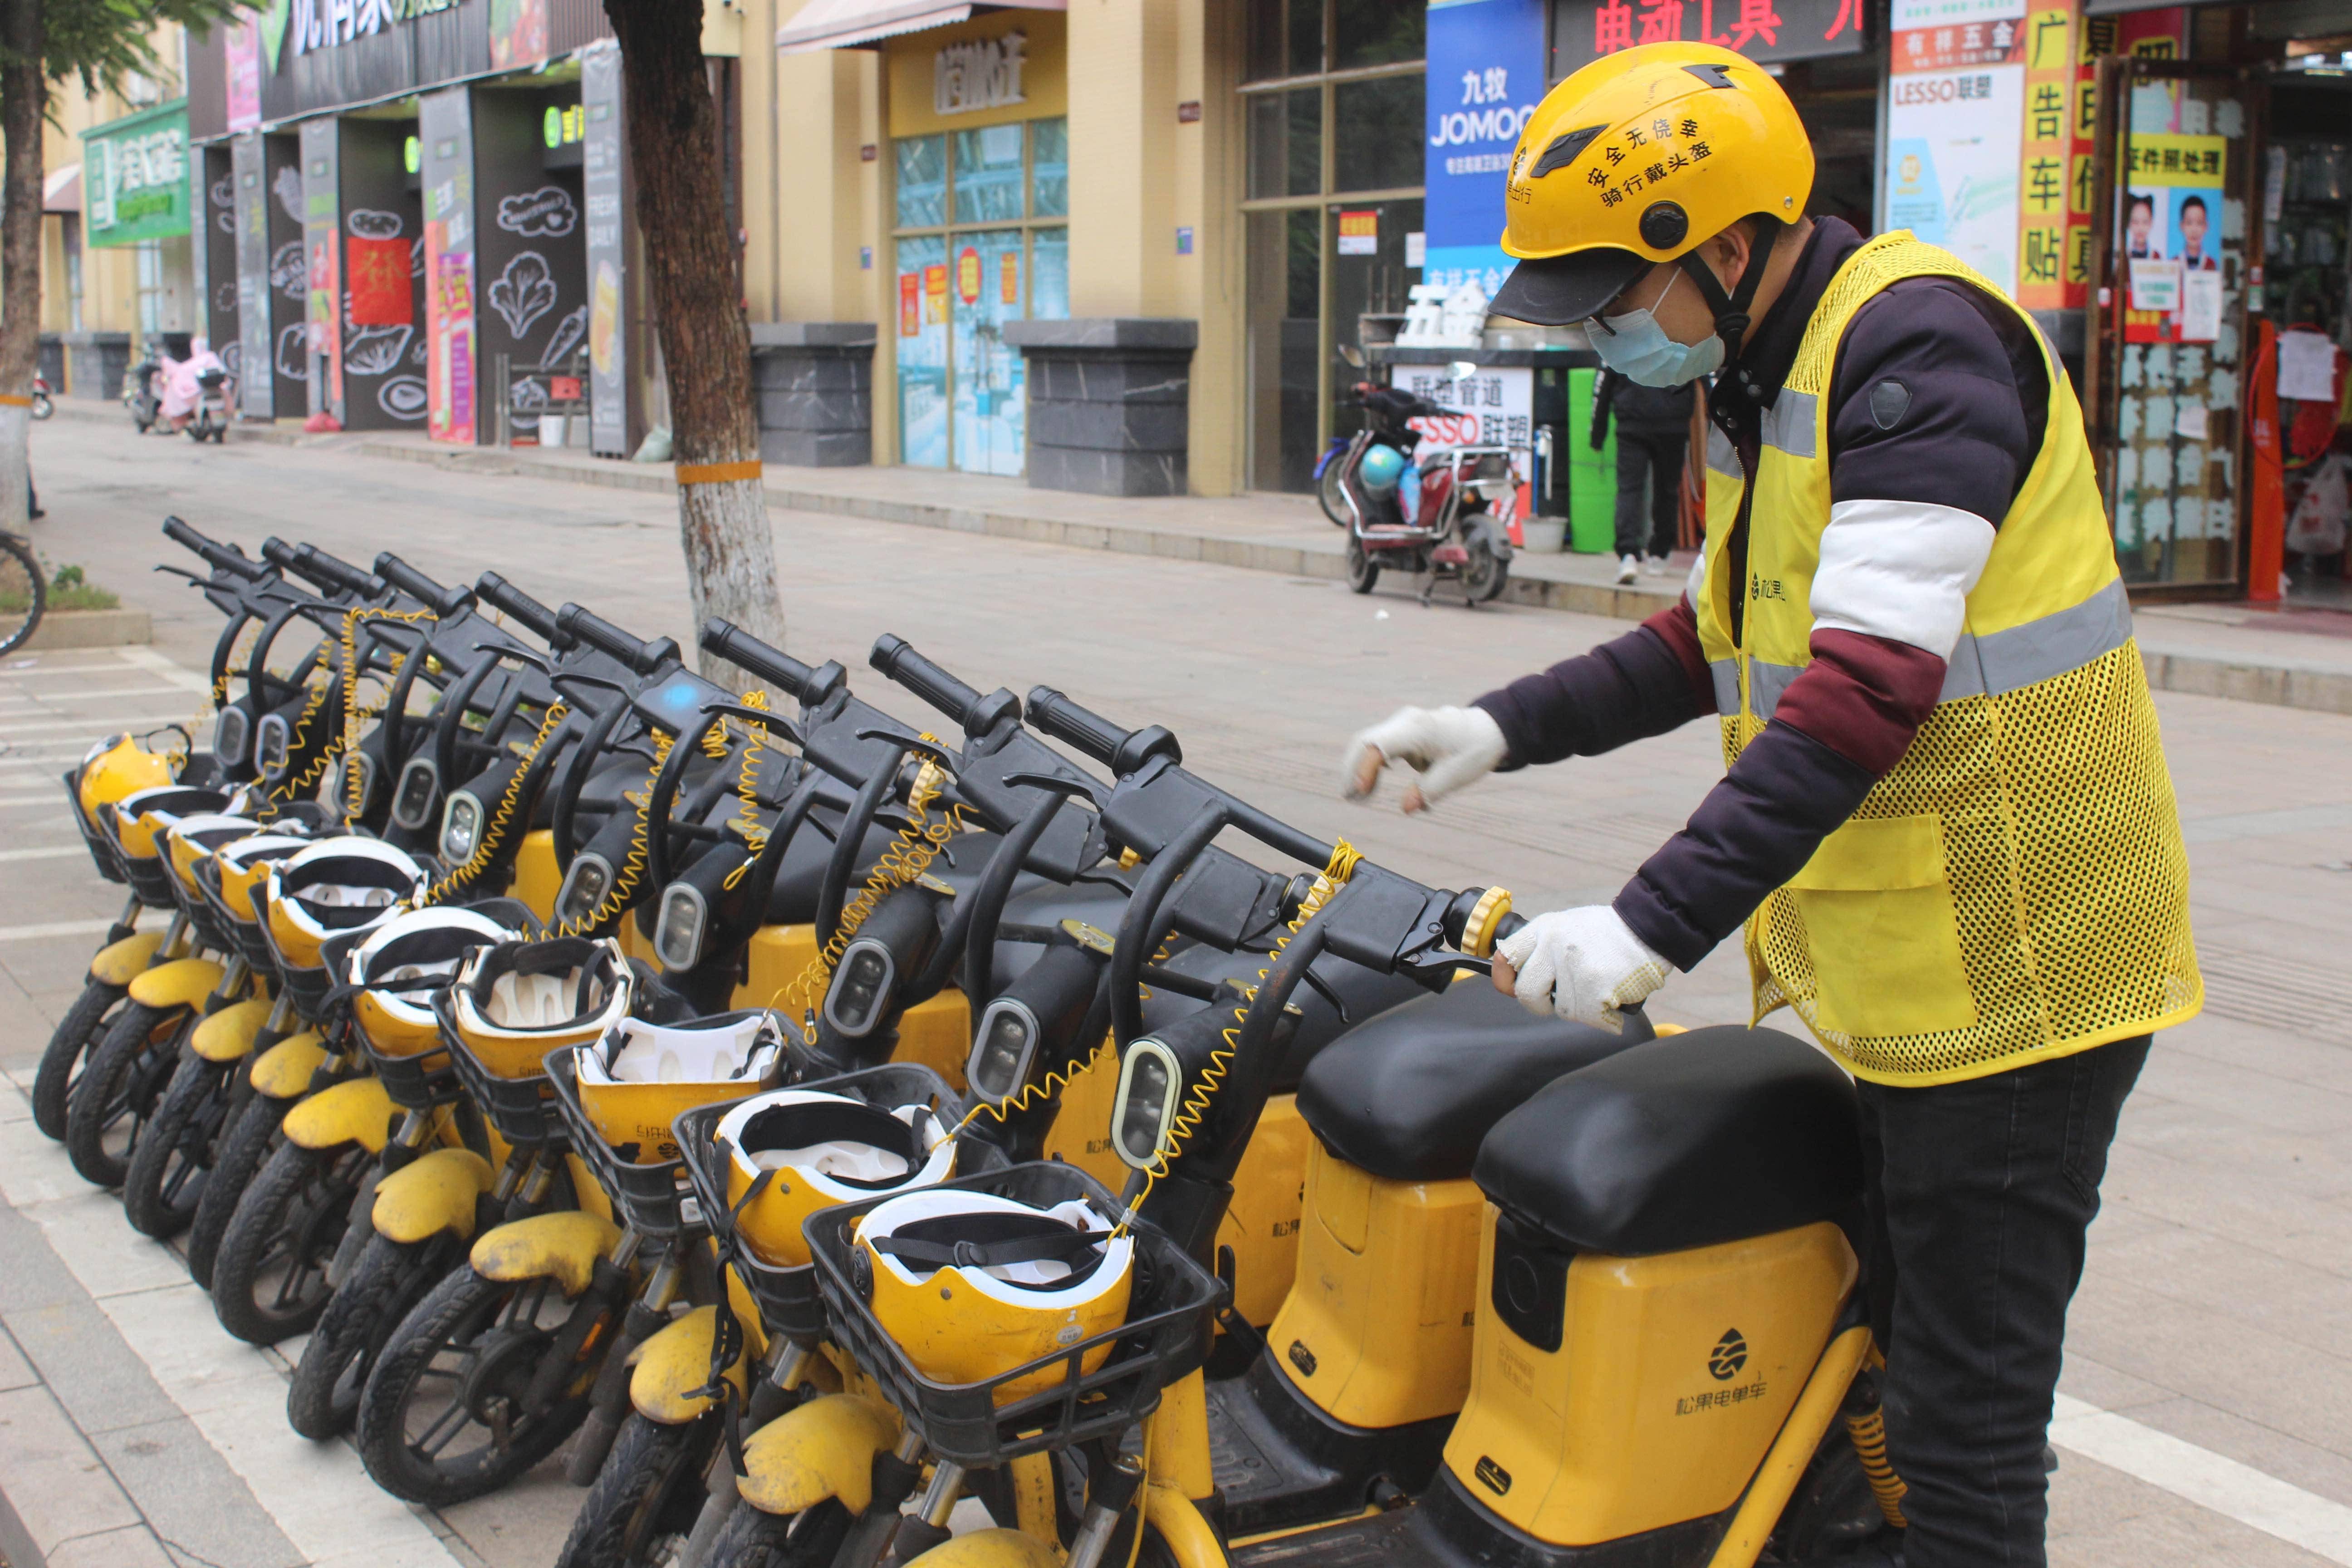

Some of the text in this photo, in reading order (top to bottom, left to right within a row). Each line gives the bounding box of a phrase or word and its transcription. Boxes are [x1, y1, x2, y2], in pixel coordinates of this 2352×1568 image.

[1595, 0, 1782, 54] 电动工具
[1461, 67, 1507, 105] 九牧
[1895, 80, 1954, 106] LESSO
[1588, 119, 1698, 188] 安全无侥幸
[1600, 141, 1712, 208] 骑行戴头盔
[2025, 13, 2067, 282] 广告车贴
[1676, 1371, 1767, 1416] 松果电单车
